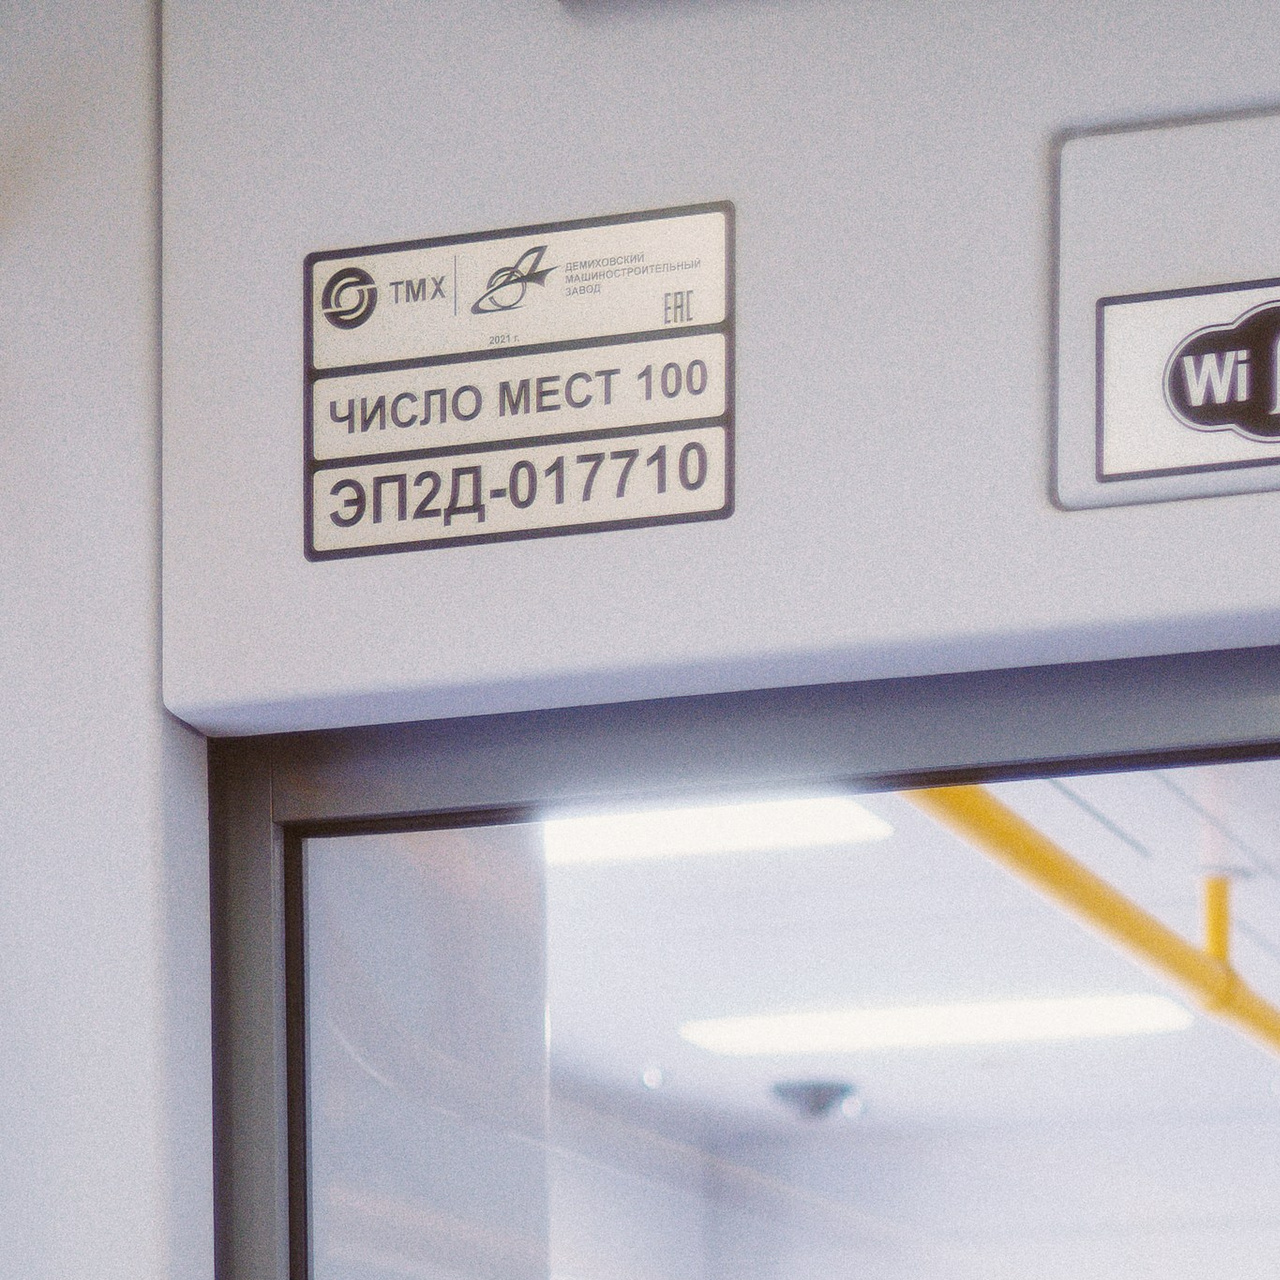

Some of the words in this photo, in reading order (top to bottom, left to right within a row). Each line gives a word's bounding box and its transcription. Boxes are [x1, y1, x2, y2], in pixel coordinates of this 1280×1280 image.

[564, 253, 645, 272] ДЕМИХОВСКИЙ
[564, 258, 702, 284] МАШИНОСТРОИТЕЛЬНЫЙ
[564, 283, 602, 297] ЗАВОД
[489, 333, 511, 345] 2021
[329, 384, 483, 435] ЧИСЛО
[498, 368, 622, 418] МЕСТ
[636, 358, 709, 401] 100
[329, 441, 709, 529] ЭП2Д-017710
